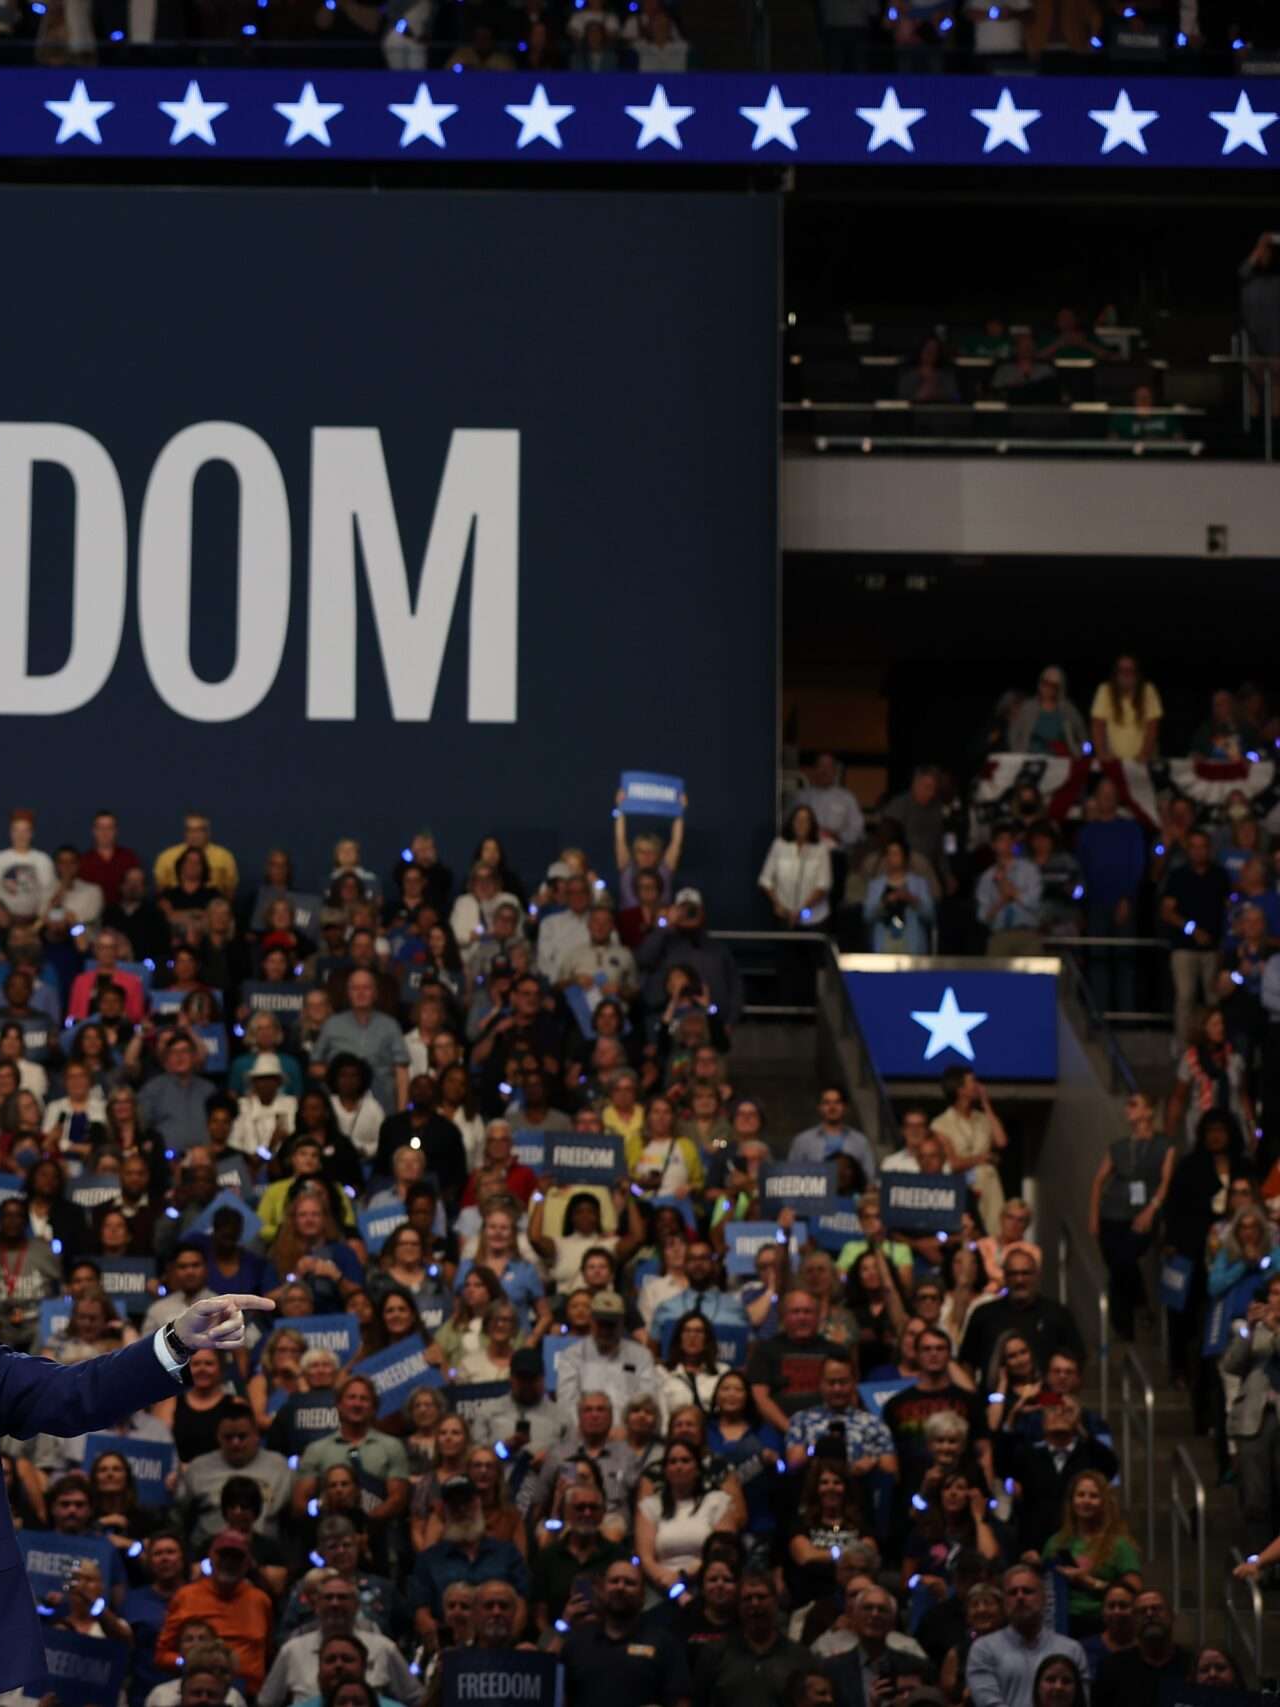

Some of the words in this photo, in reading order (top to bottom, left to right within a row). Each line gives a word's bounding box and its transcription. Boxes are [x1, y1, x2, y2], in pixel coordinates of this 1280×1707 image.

[888, 1185, 955, 1211] FREEDOM
[294, 1407, 339, 1430] FREEDO
[456, 1671, 542, 1703] FREEDOM
